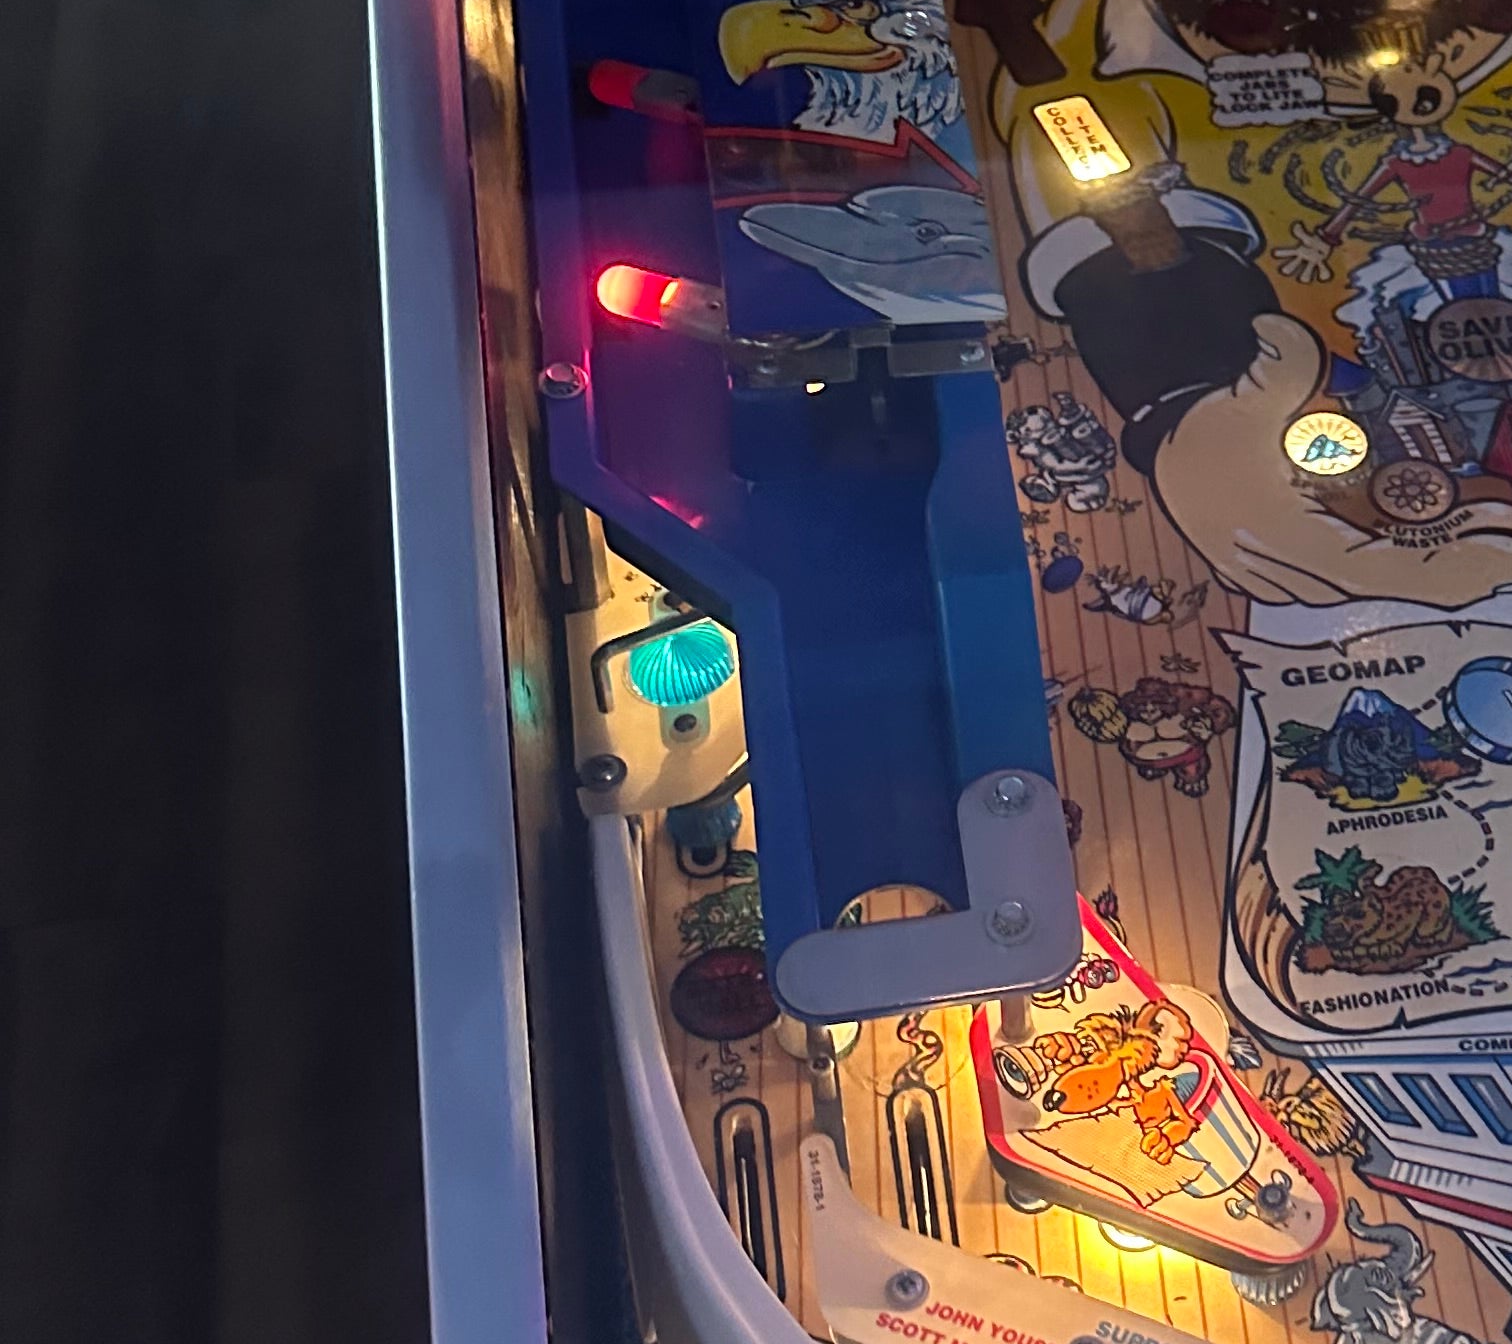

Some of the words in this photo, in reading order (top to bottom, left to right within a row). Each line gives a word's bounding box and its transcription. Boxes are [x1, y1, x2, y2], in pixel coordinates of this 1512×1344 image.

[1209, 67, 1313, 82] COMPLETE
[1219, 101, 1272, 113] LOCK
[1229, 92, 1257, 102] TO
[1391, 532, 1453, 549] WASTE
[1281, 655, 1426, 687] GEOMAP
[1326, 805, 1448, 835] APHRODESIA
[1300, 979, 1451, 1016] FASHIONATION
[925, 1301, 985, 1333] JOHN
